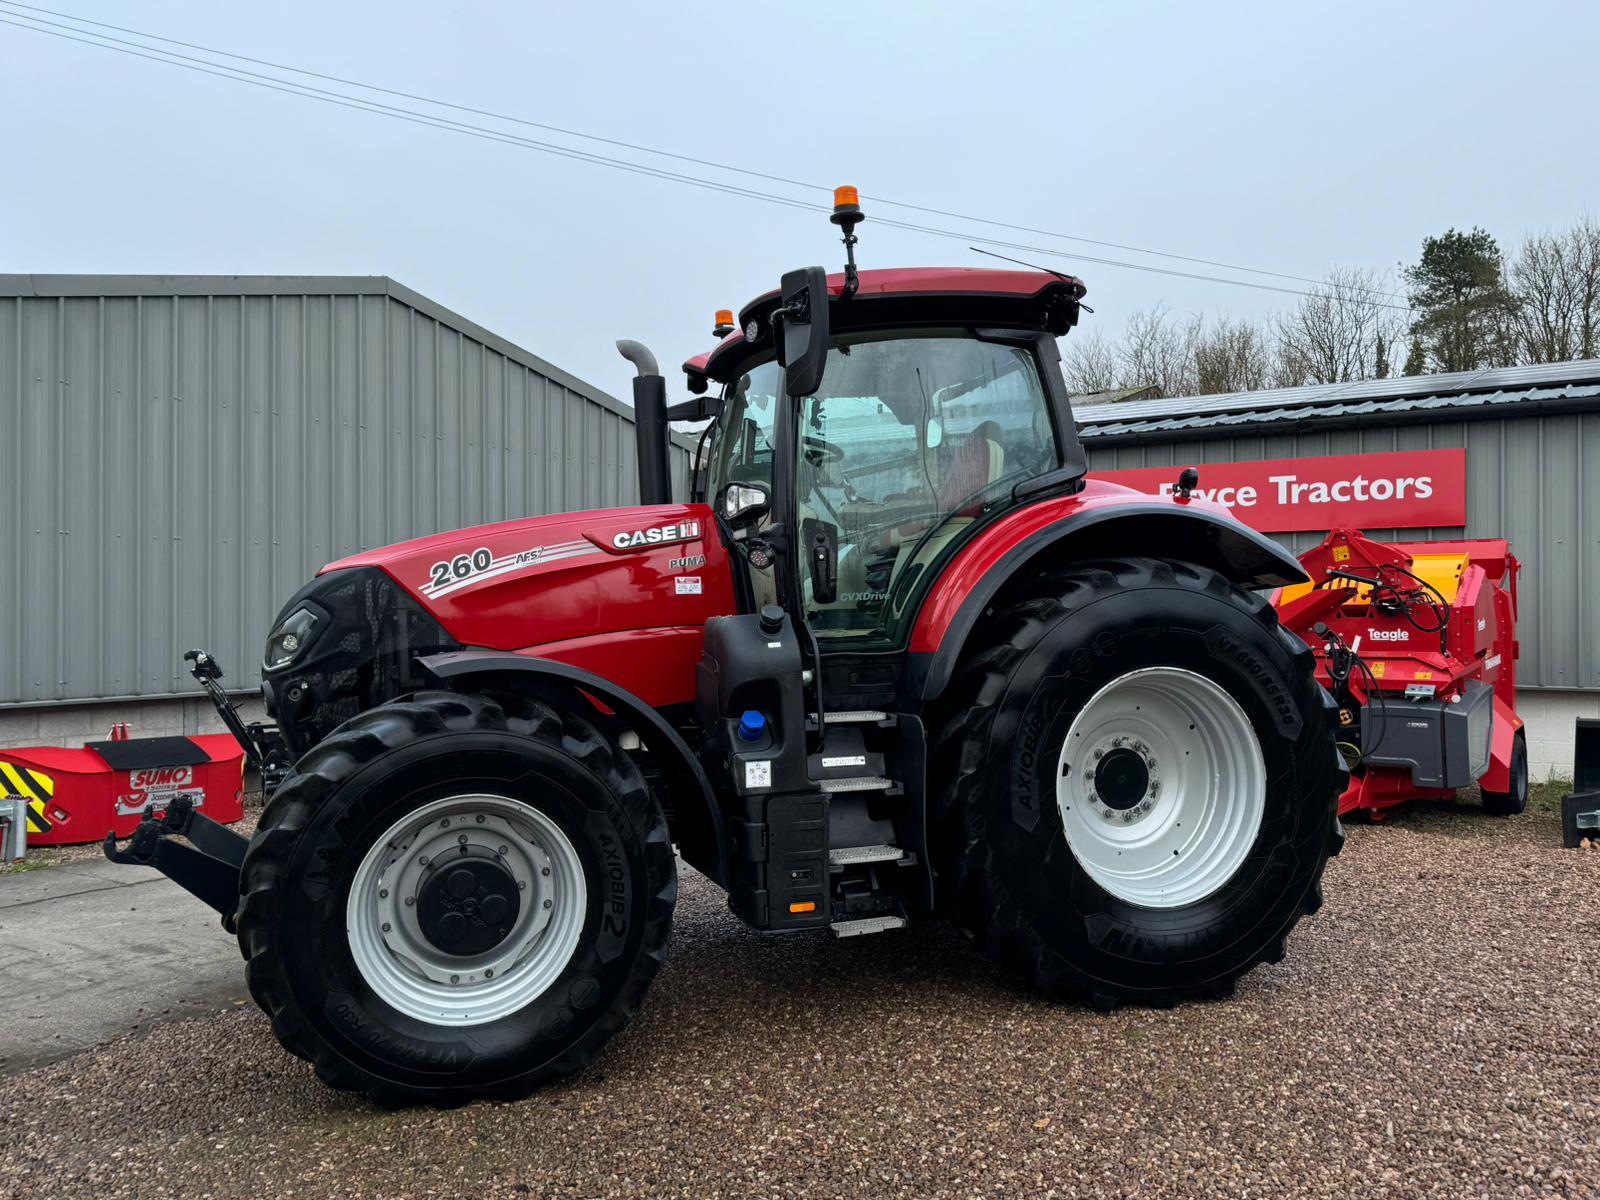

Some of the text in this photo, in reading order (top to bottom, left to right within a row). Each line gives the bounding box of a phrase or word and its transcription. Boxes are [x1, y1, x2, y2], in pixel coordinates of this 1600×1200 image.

[1159, 473, 1433, 507] Pyce Tractors
[613, 525, 676, 548] CASE
[429, 547, 493, 588] 260
[669, 555, 706, 569] PUMA
[840, 591, 891, 601] CVXDrive
[1367, 628, 1409, 642] Teagle
[134, 767, 188, 787] SUMO
